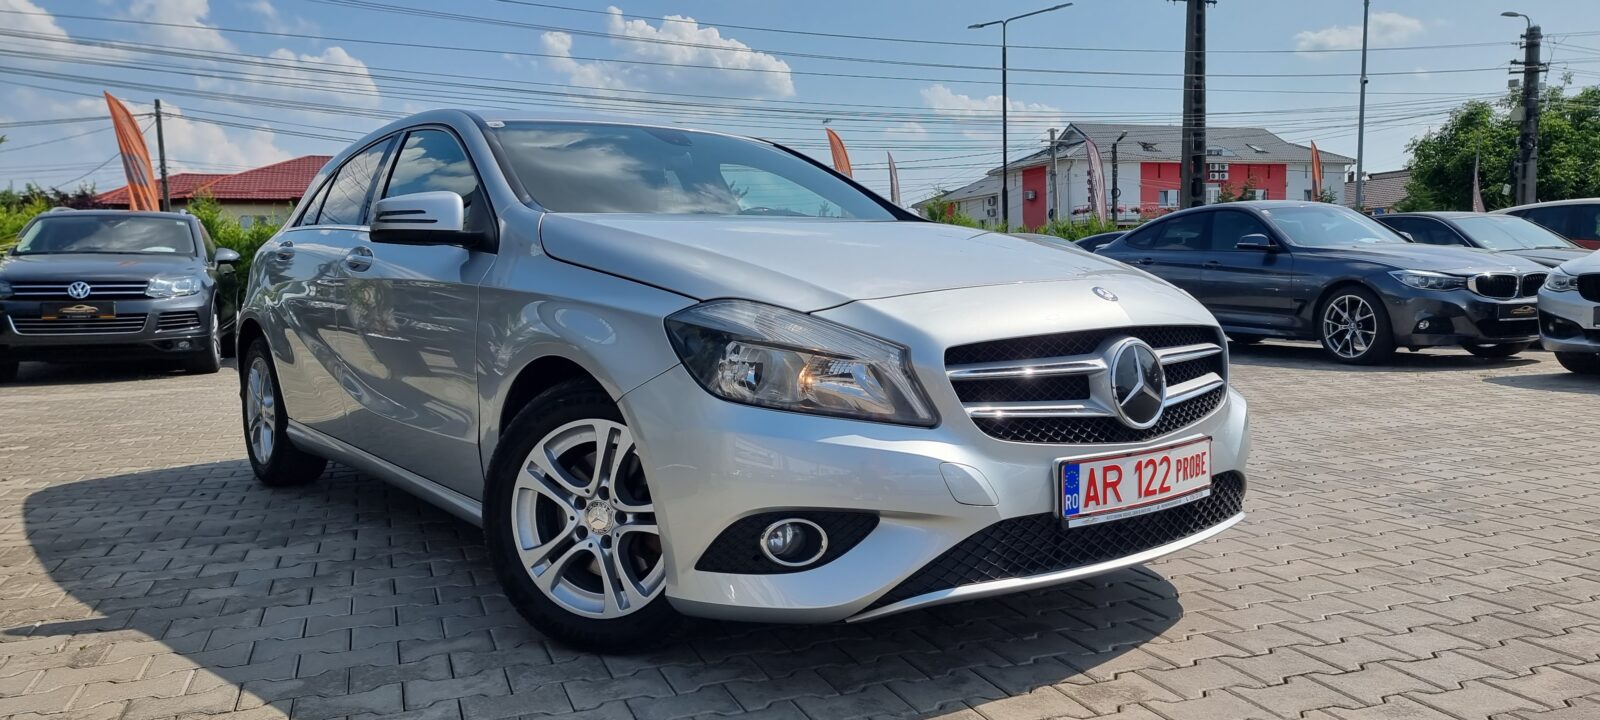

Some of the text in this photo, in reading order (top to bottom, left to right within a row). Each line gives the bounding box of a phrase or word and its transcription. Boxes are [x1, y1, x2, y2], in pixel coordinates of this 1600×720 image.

[68, 281, 91, 299] VW
[1083, 451, 1207, 508] AR 122 PROBE
[1065, 493, 1079, 511] RO
